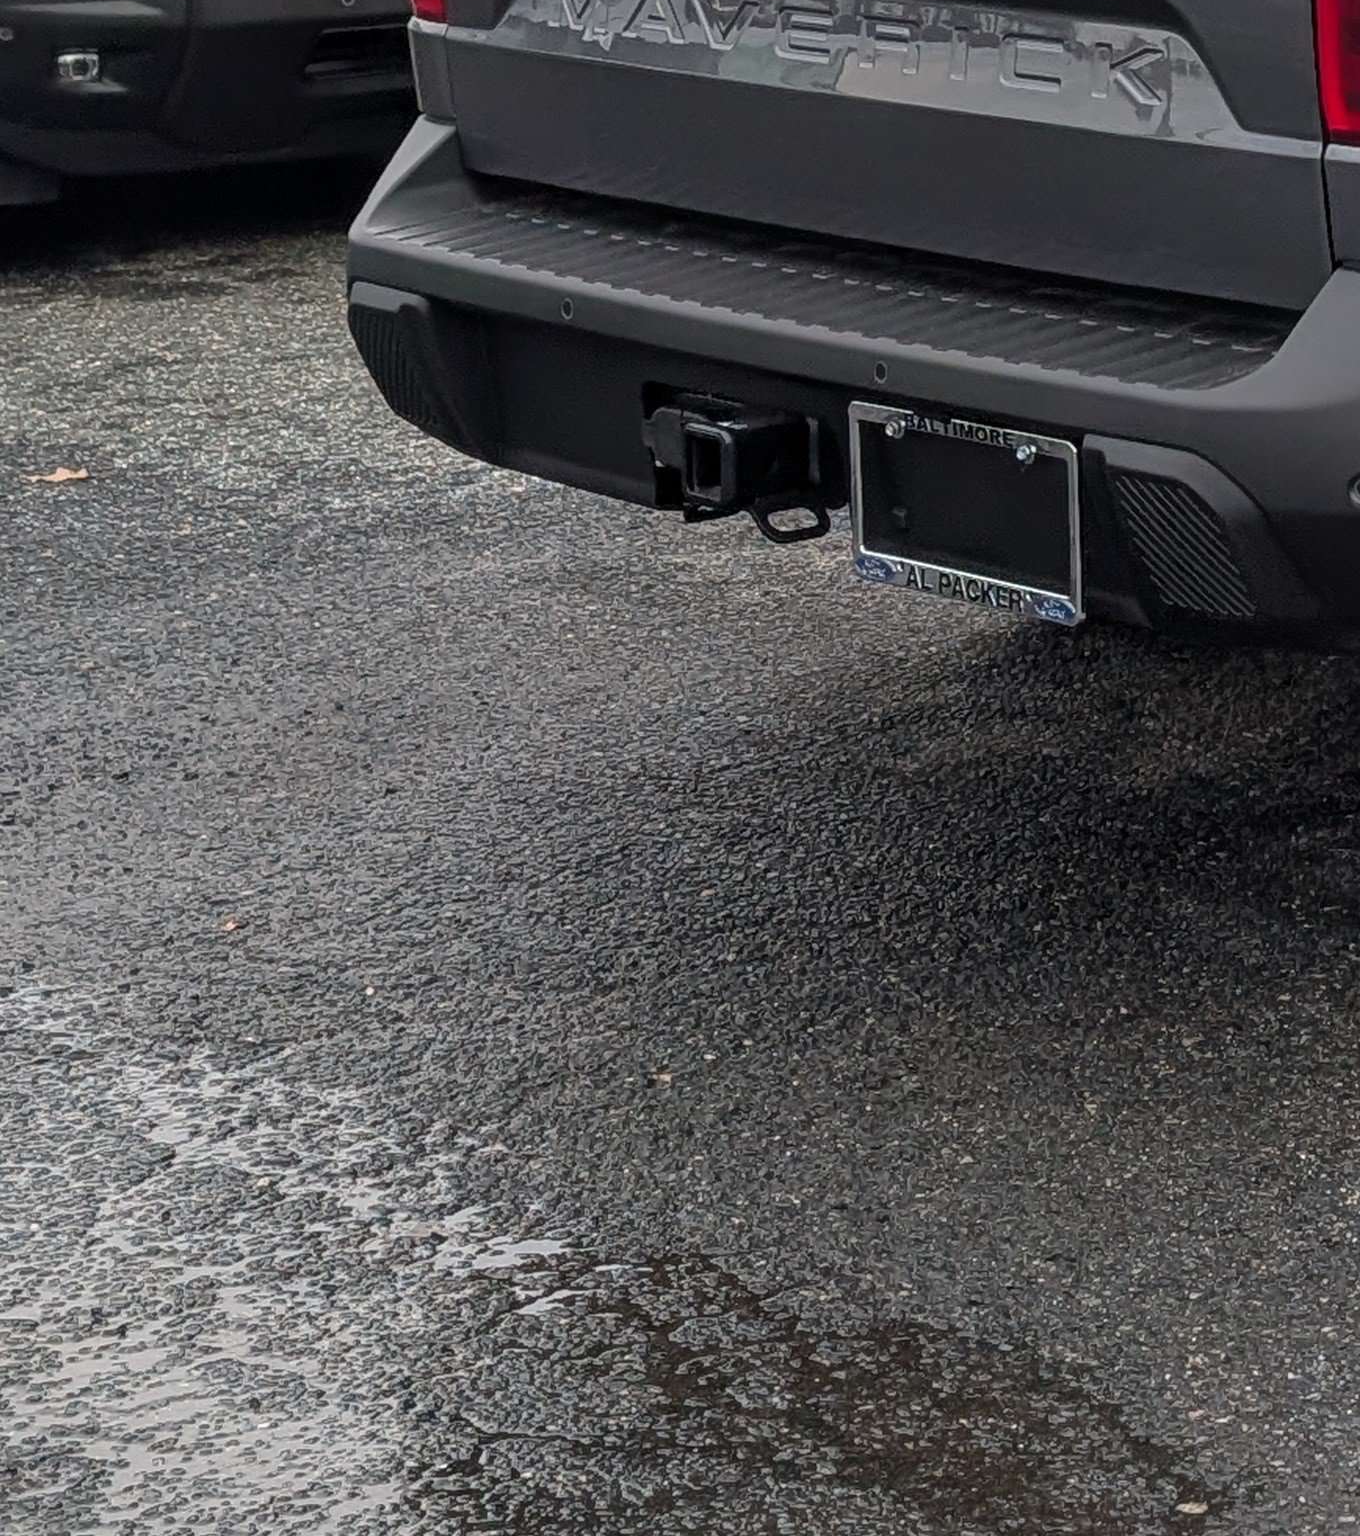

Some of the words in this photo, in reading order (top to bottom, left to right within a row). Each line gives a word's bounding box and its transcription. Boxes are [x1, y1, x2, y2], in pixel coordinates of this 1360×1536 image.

[904, 414, 1018, 449] BALTIMORE
[906, 564, 933, 591] AL
[938, 571, 1023, 614] PACKER
